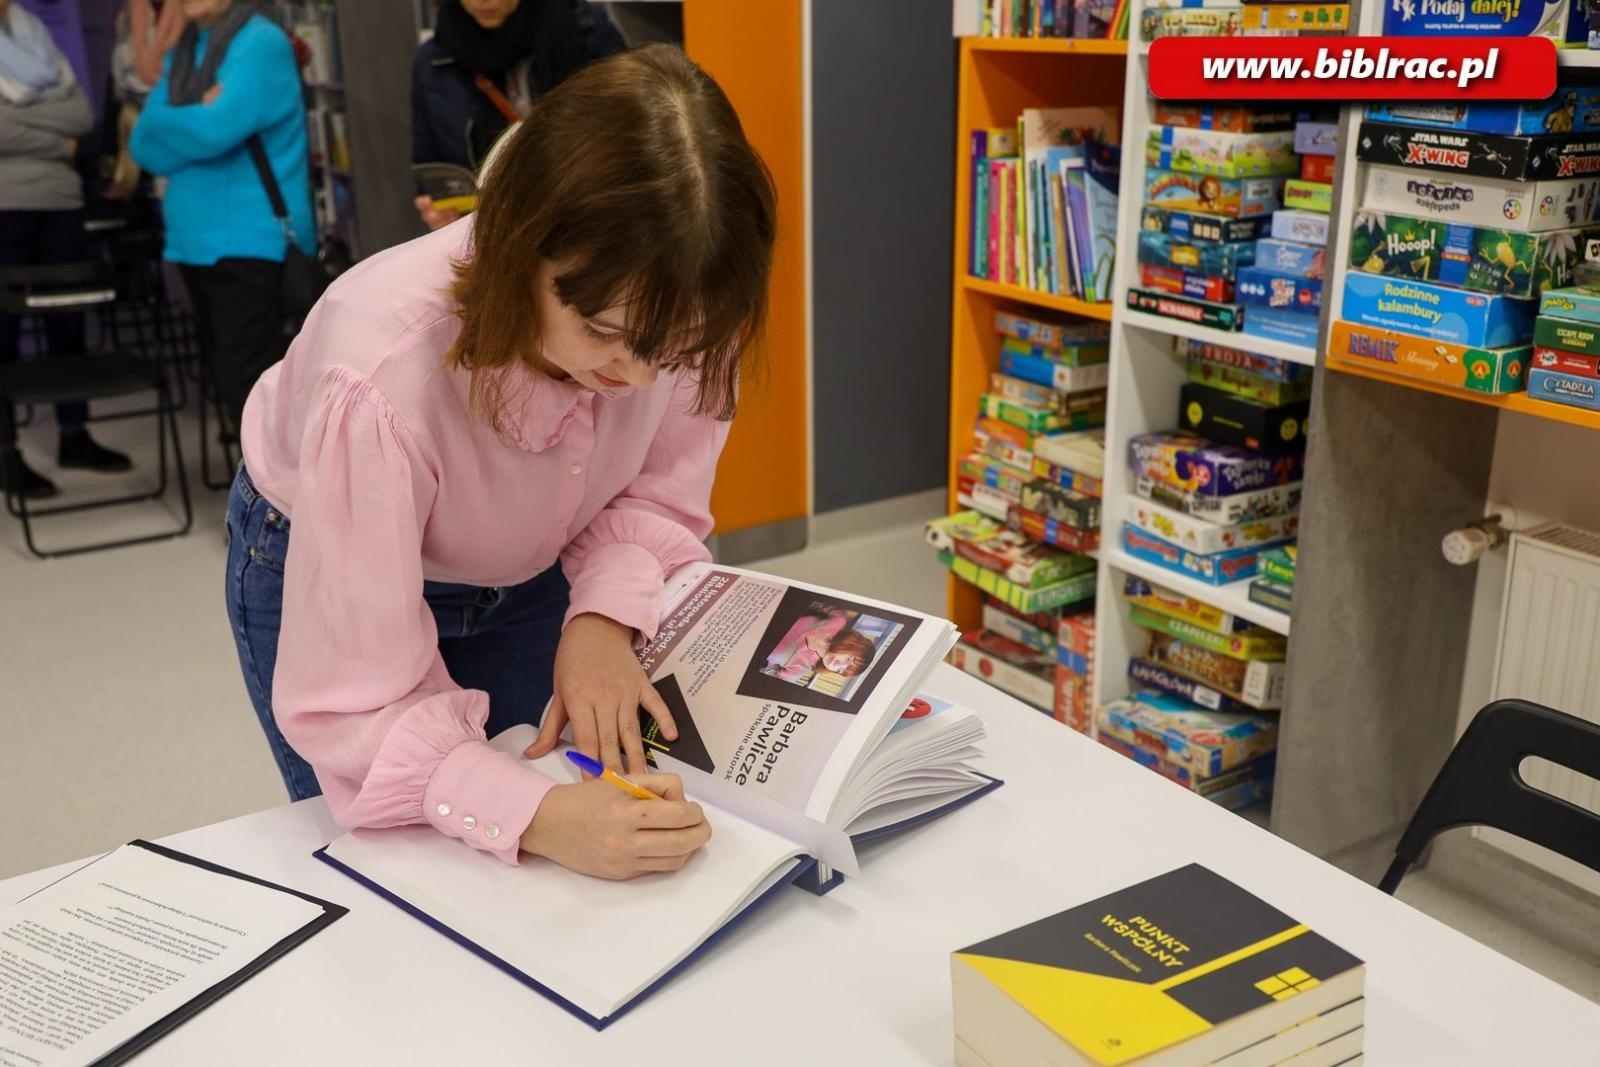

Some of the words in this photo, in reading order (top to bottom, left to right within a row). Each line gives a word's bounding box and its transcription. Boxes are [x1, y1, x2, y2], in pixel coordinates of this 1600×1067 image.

[1421, 0, 1465, 22] Podaj
[1471, 0, 1520, 22] dalej!
[1411, 132, 1438, 144] STAR
[1439, 134, 1469, 147] WARS
[1406, 142, 1469, 168] X-WING
[1557, 155, 1600, 176] X-WIN
[1387, 228, 1436, 256] Hooop!
[1384, 283, 1440, 304] Rodzinne
[1378, 298, 1441, 324] kalambury
[1348, 333, 1398, 364] REMIK
[716, 576, 730, 590] 28
[674, 588, 719, 629] listopada,
[662, 619, 678, 632] ul.
[653, 629, 679, 655] godz.
[742, 703, 771, 744] spotkanie
[735, 705, 791, 786] Pawlicze
[756, 711, 808, 783] Barbara
[724, 745, 744, 781] autorsk
[1128, 916, 1190, 953] PUNKT
